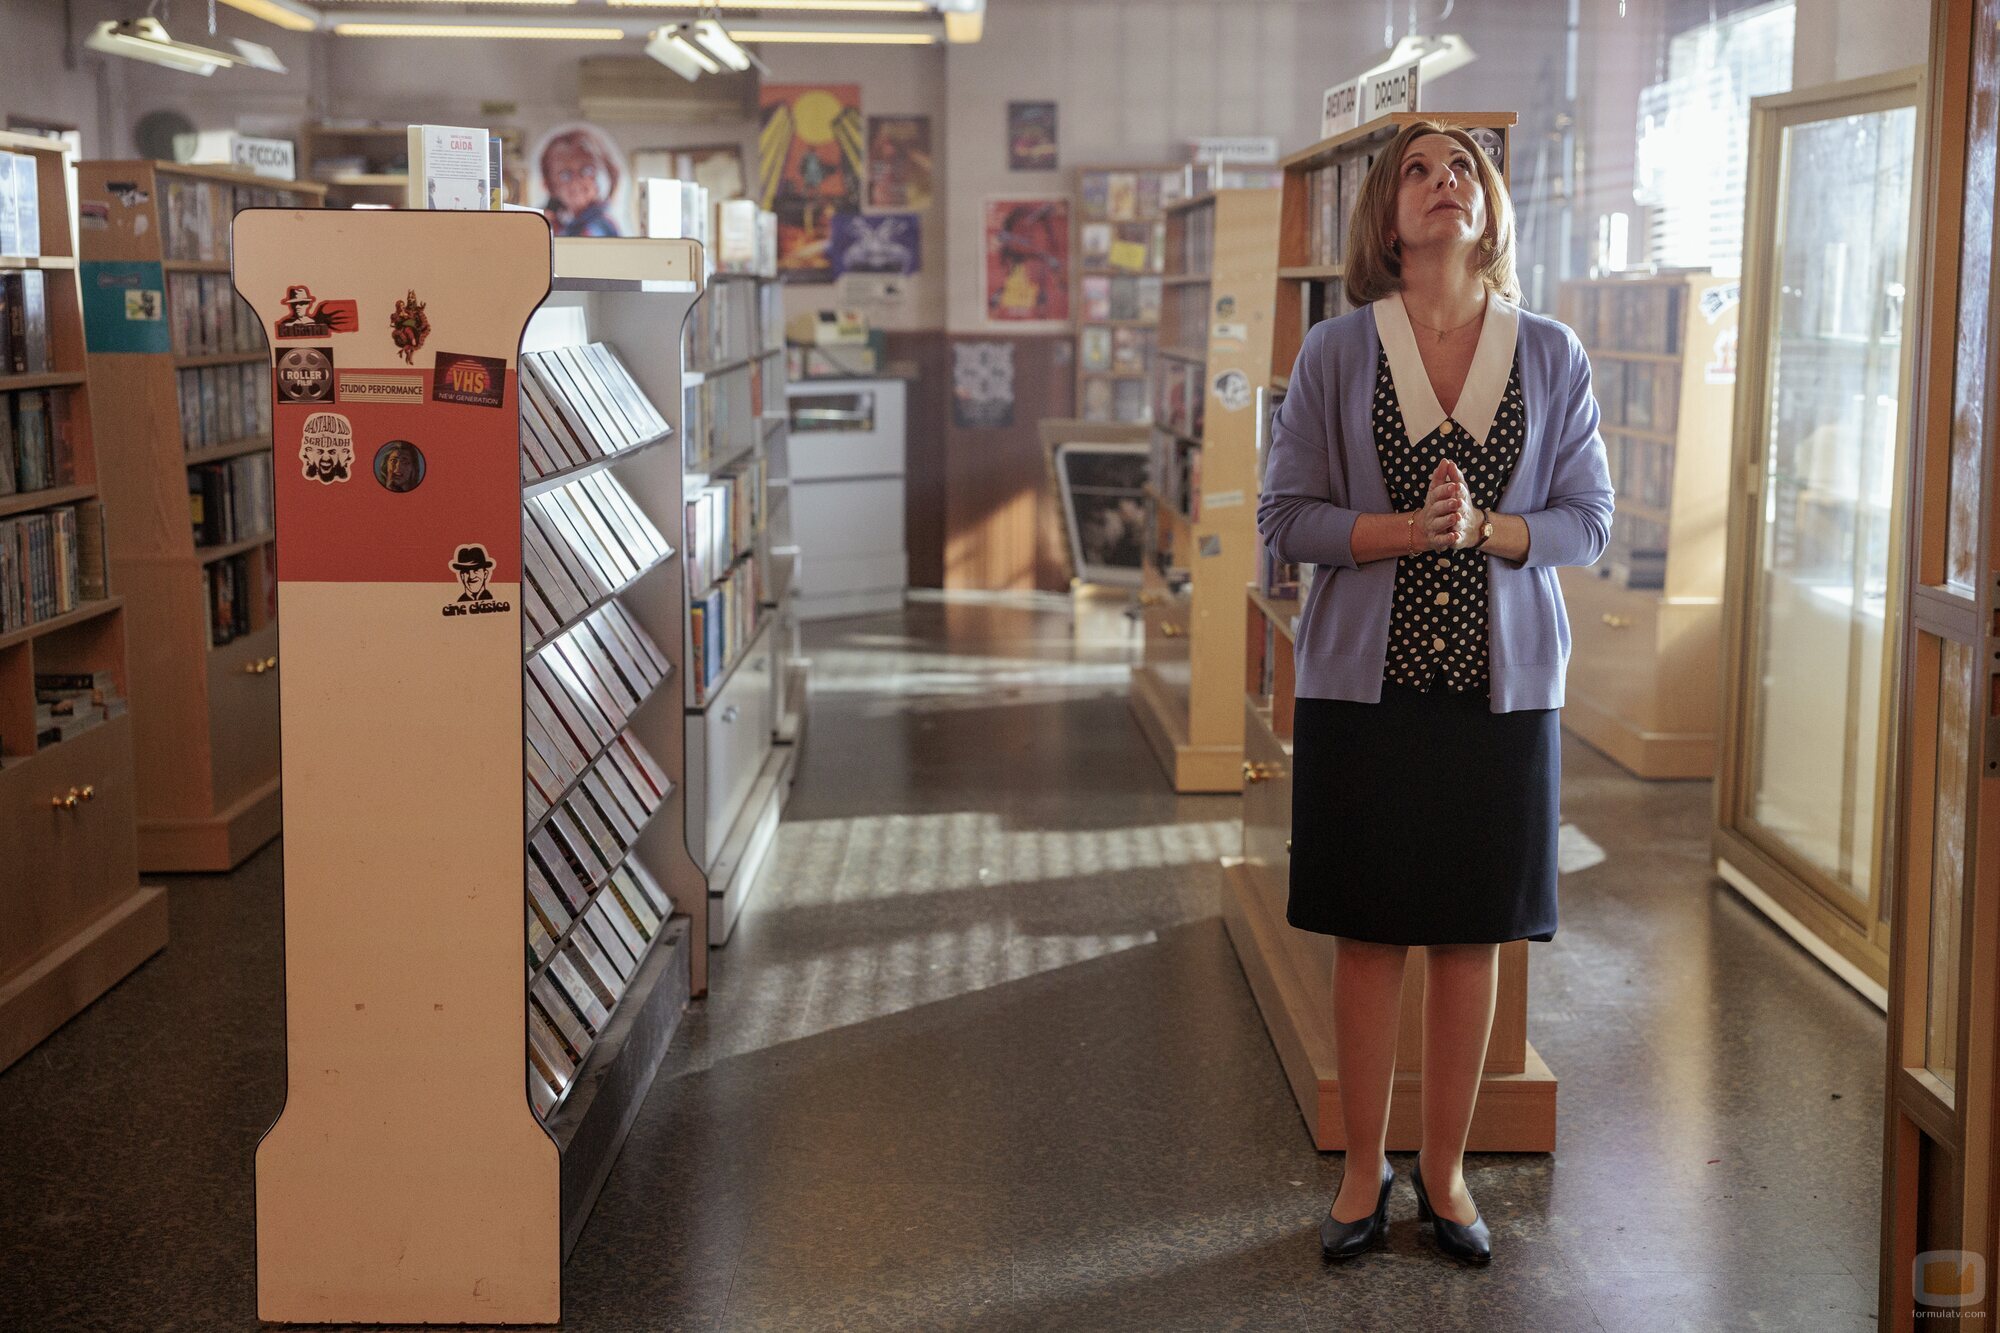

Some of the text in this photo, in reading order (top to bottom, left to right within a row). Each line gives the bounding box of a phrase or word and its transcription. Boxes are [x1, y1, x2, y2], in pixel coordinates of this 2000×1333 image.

[1375, 75, 1406, 111] DRAMA
[286, 370, 322, 380] ROLLER
[452, 367, 485, 394] VHS
[340, 384, 423, 395] STUDIO PERFORMANCE
[438, 392, 498, 405] NEW GENERATION
[442, 604, 467, 617] cine
